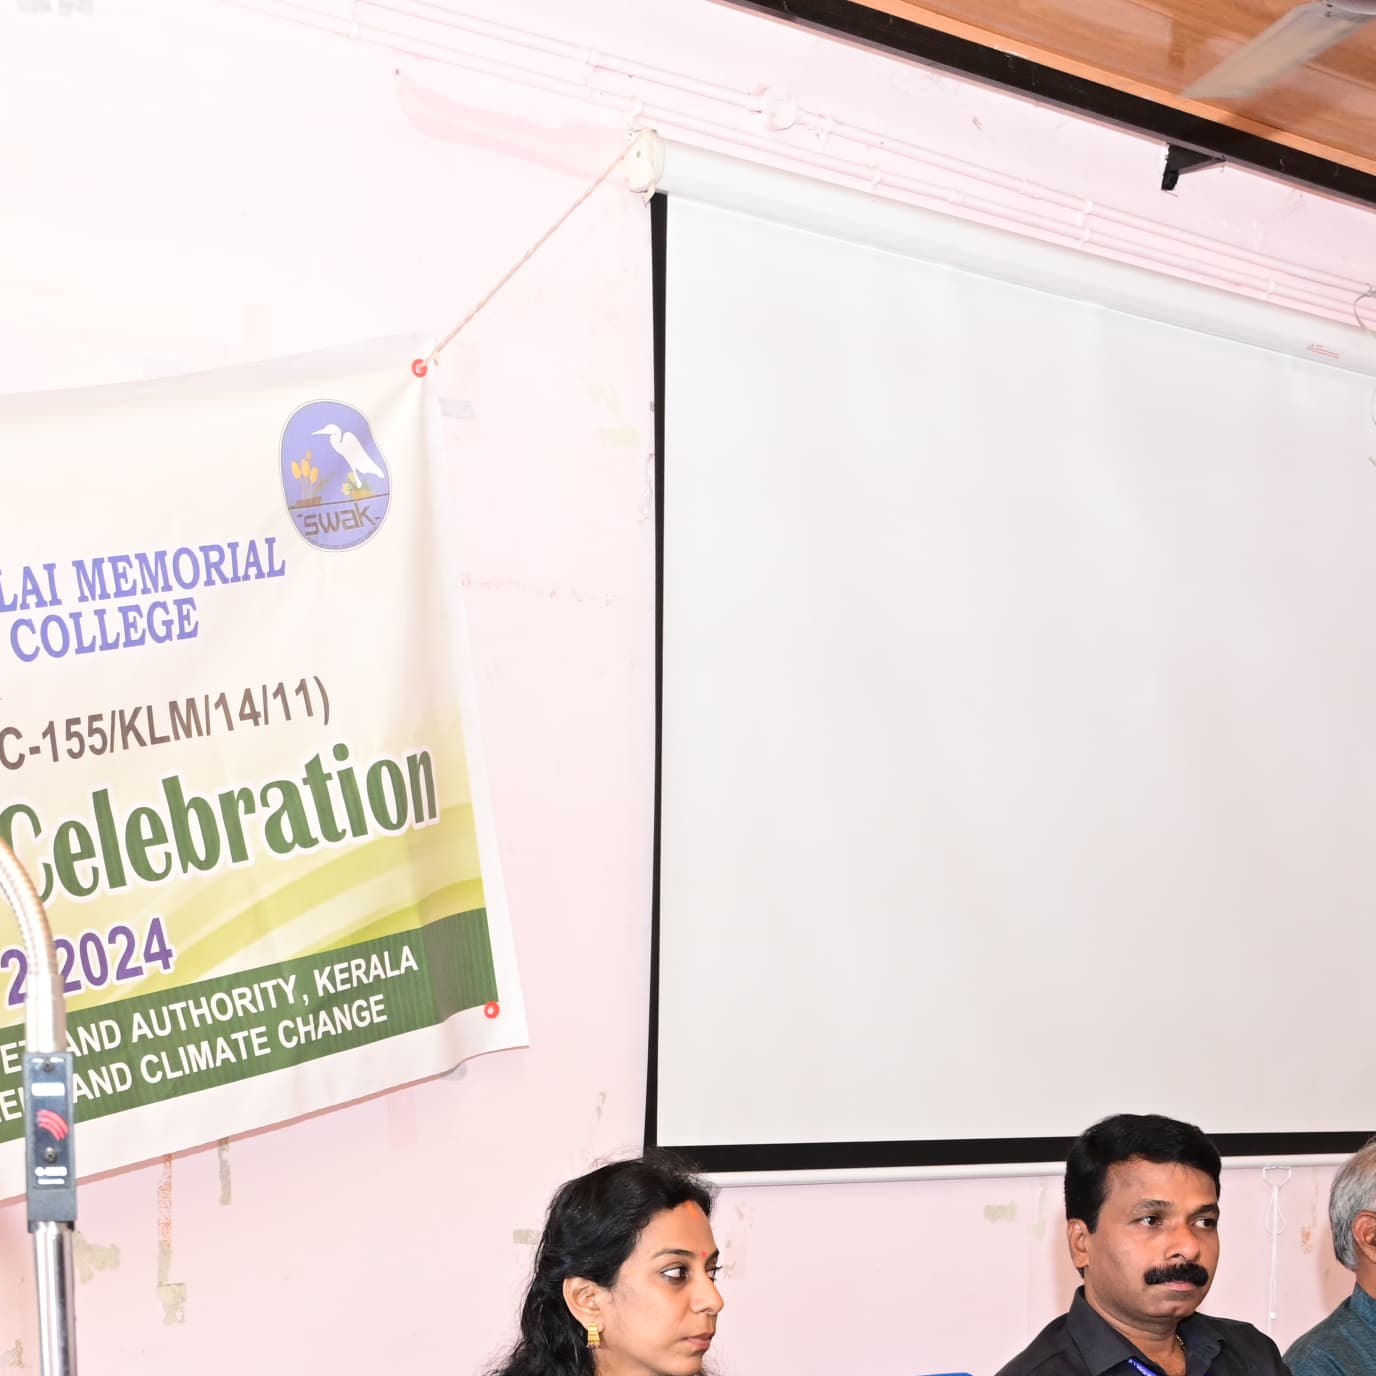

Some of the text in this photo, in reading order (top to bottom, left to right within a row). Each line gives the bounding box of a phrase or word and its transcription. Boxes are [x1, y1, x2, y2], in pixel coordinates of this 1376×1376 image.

[71, 536, 287, 603] MEMORIAL
[10, 597, 200, 663] COLLEGE
[54, 917, 174, 994] 2024
[131, 975, 309, 1044] AUTHORITY,
[314, 945, 419, 996] KERALA
[73, 1062, 133, 1104] AND
[140, 1024, 272, 1084] CLIMATE
[277, 994, 388, 1048] CHANGE
